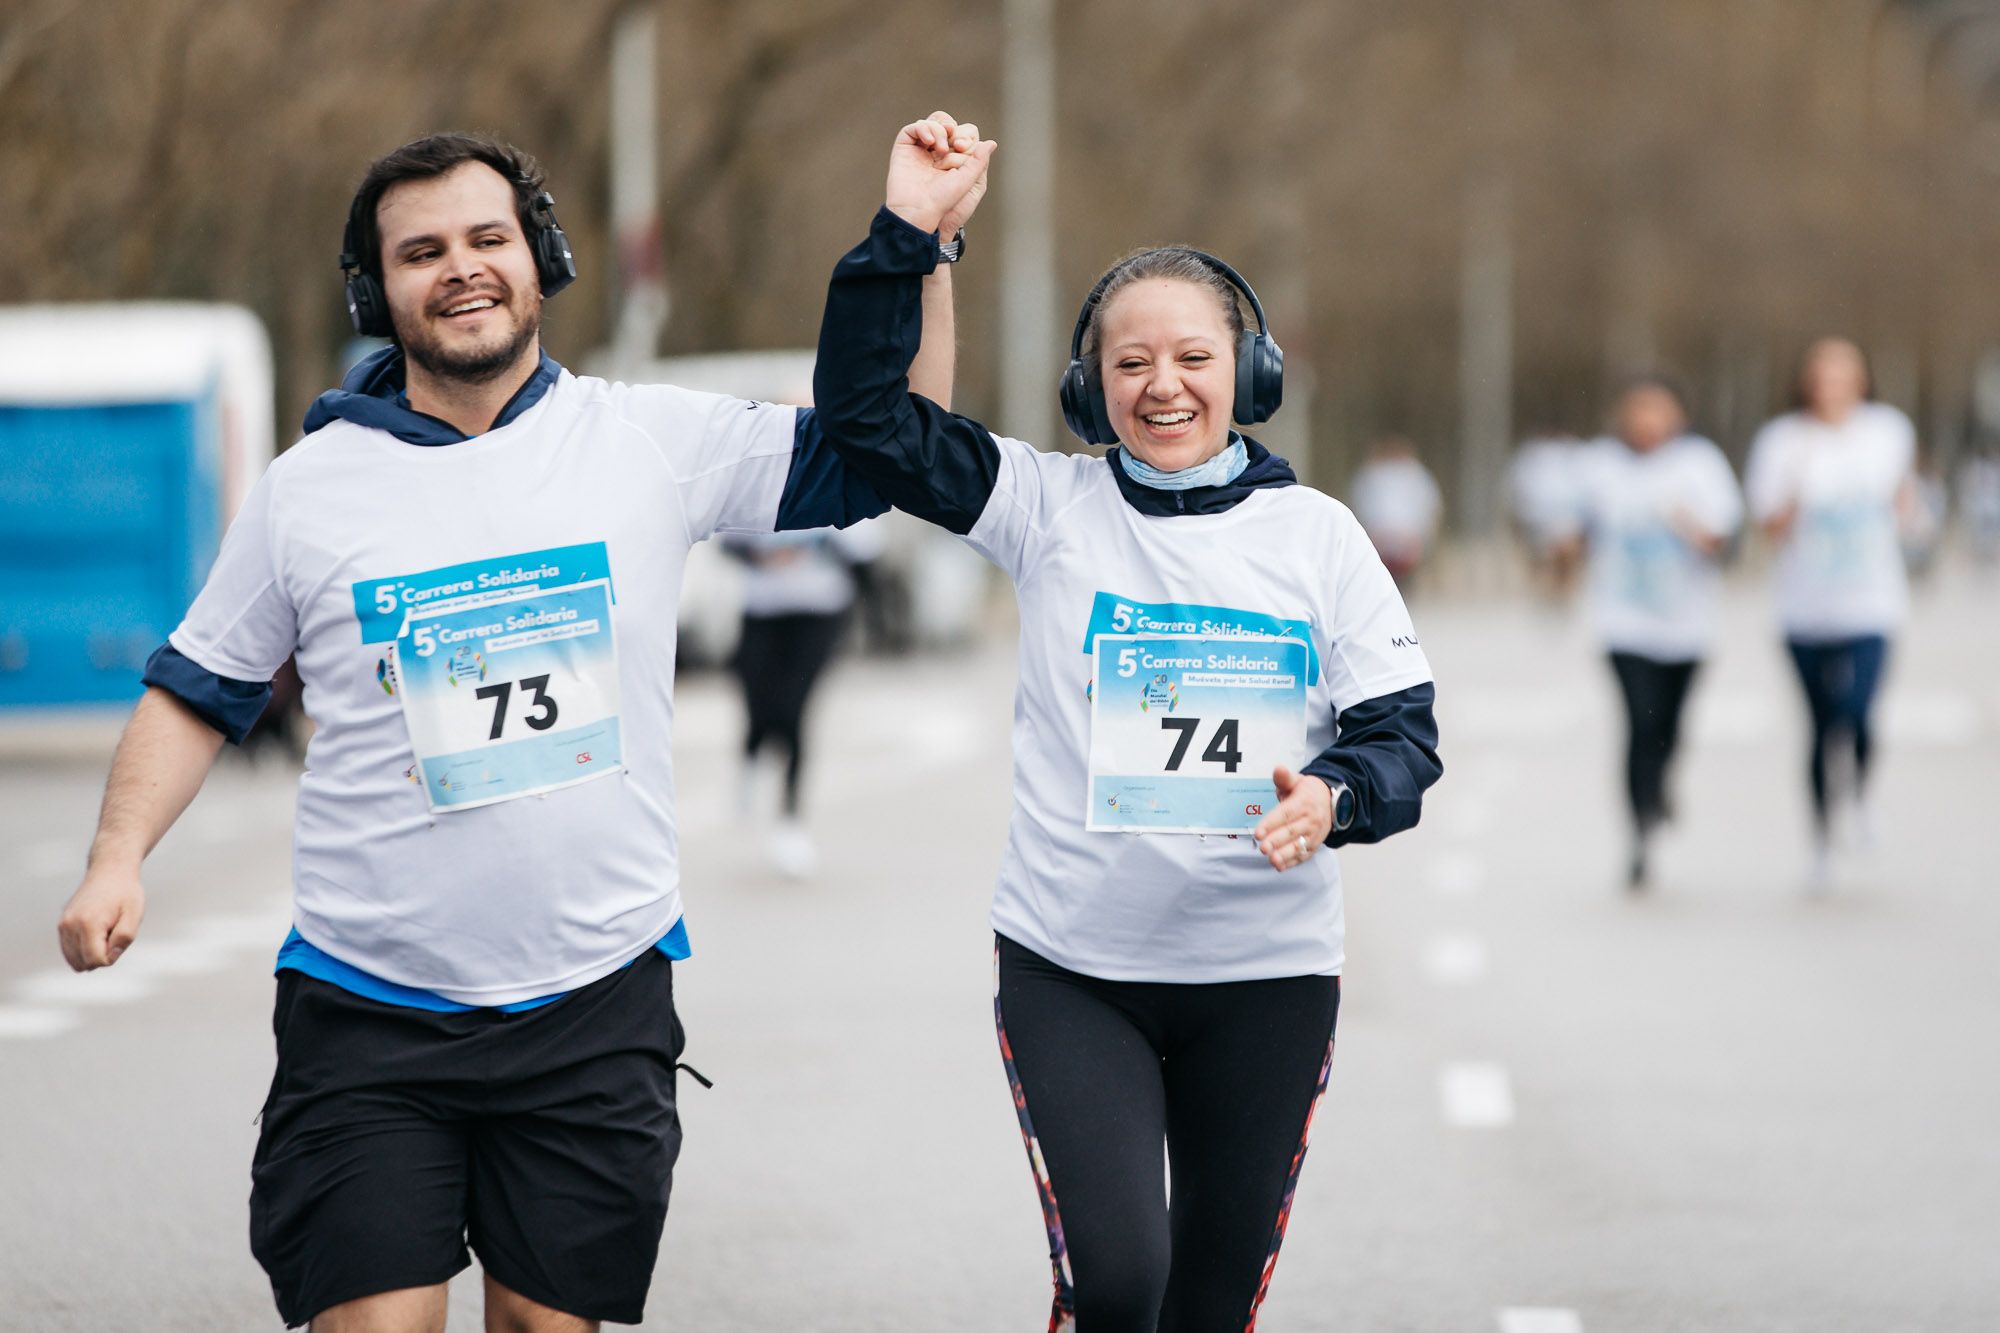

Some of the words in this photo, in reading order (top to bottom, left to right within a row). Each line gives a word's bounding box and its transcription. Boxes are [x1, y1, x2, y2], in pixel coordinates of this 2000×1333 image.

[401, 580, 474, 603] Carrera
[477, 564, 560, 588] Solidaria
[439, 623, 504, 644] Carrera
[506, 606, 578, 630] Solidaria
[1137, 616, 1197, 633] Carrera
[1142, 654, 1202, 669] Carrera
[1207, 655, 1278, 671] Solidaria
[475, 673, 558, 741] 73
[1161, 717, 1242, 773] 74
[1245, 804, 1263, 816] CSL
